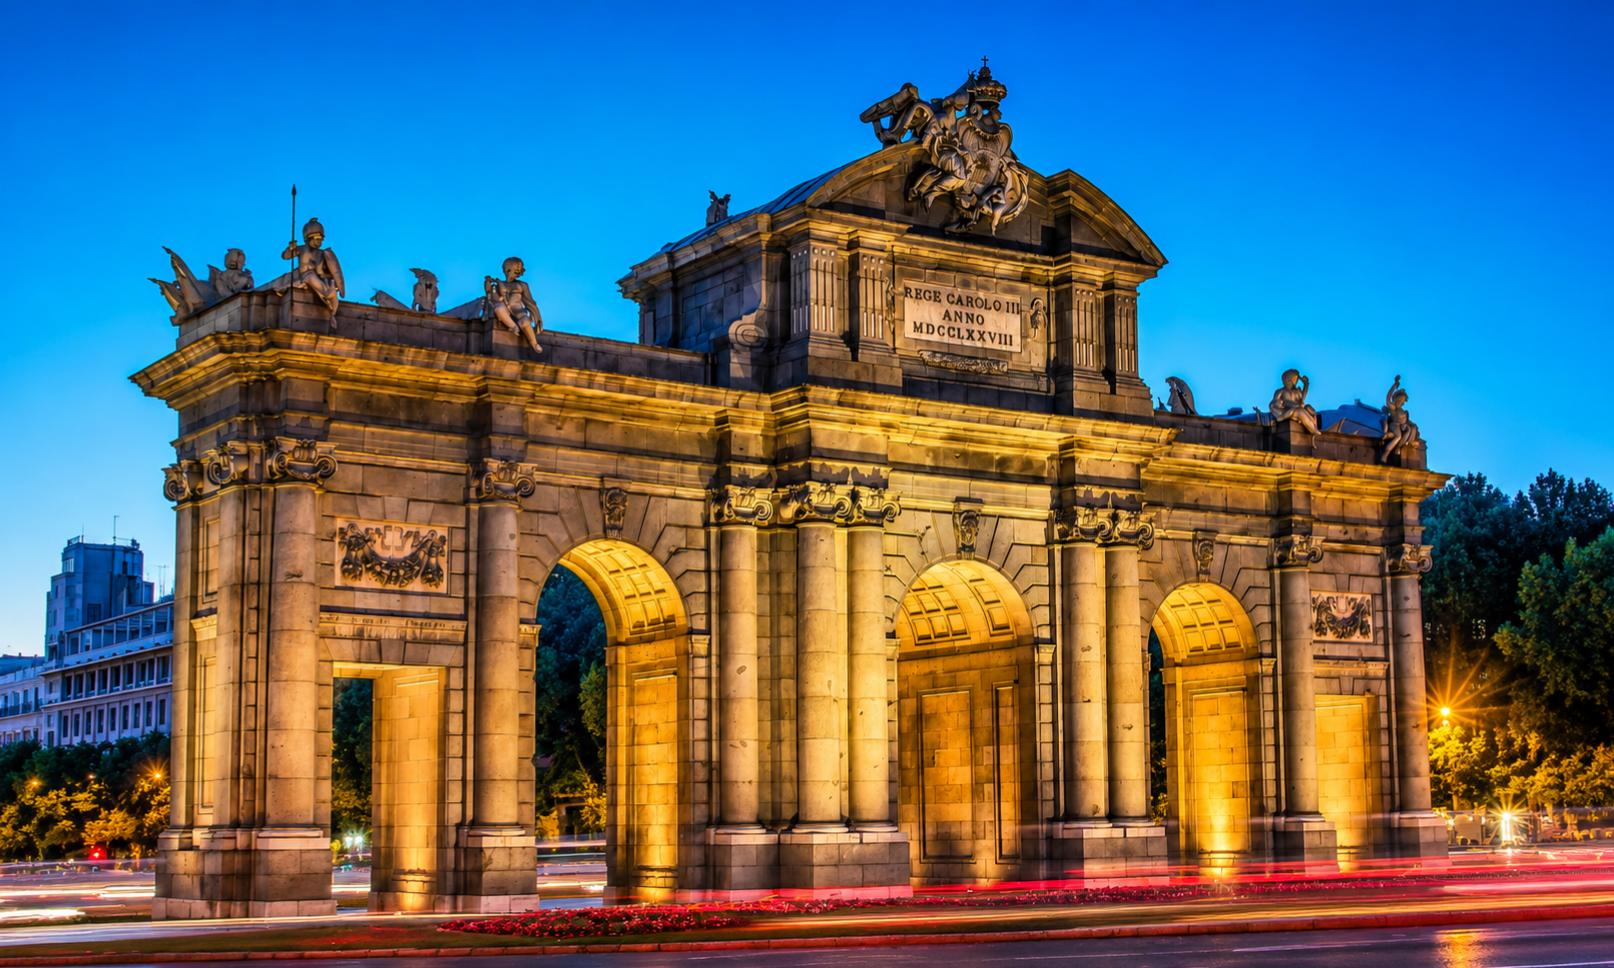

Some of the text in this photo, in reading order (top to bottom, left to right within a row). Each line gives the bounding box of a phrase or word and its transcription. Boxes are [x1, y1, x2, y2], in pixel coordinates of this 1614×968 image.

[904, 287, 1020, 315] REGE CAROLO III
[942, 309, 985, 326] ANNO
[913, 321, 1013, 346] MDCCLXXVIII
